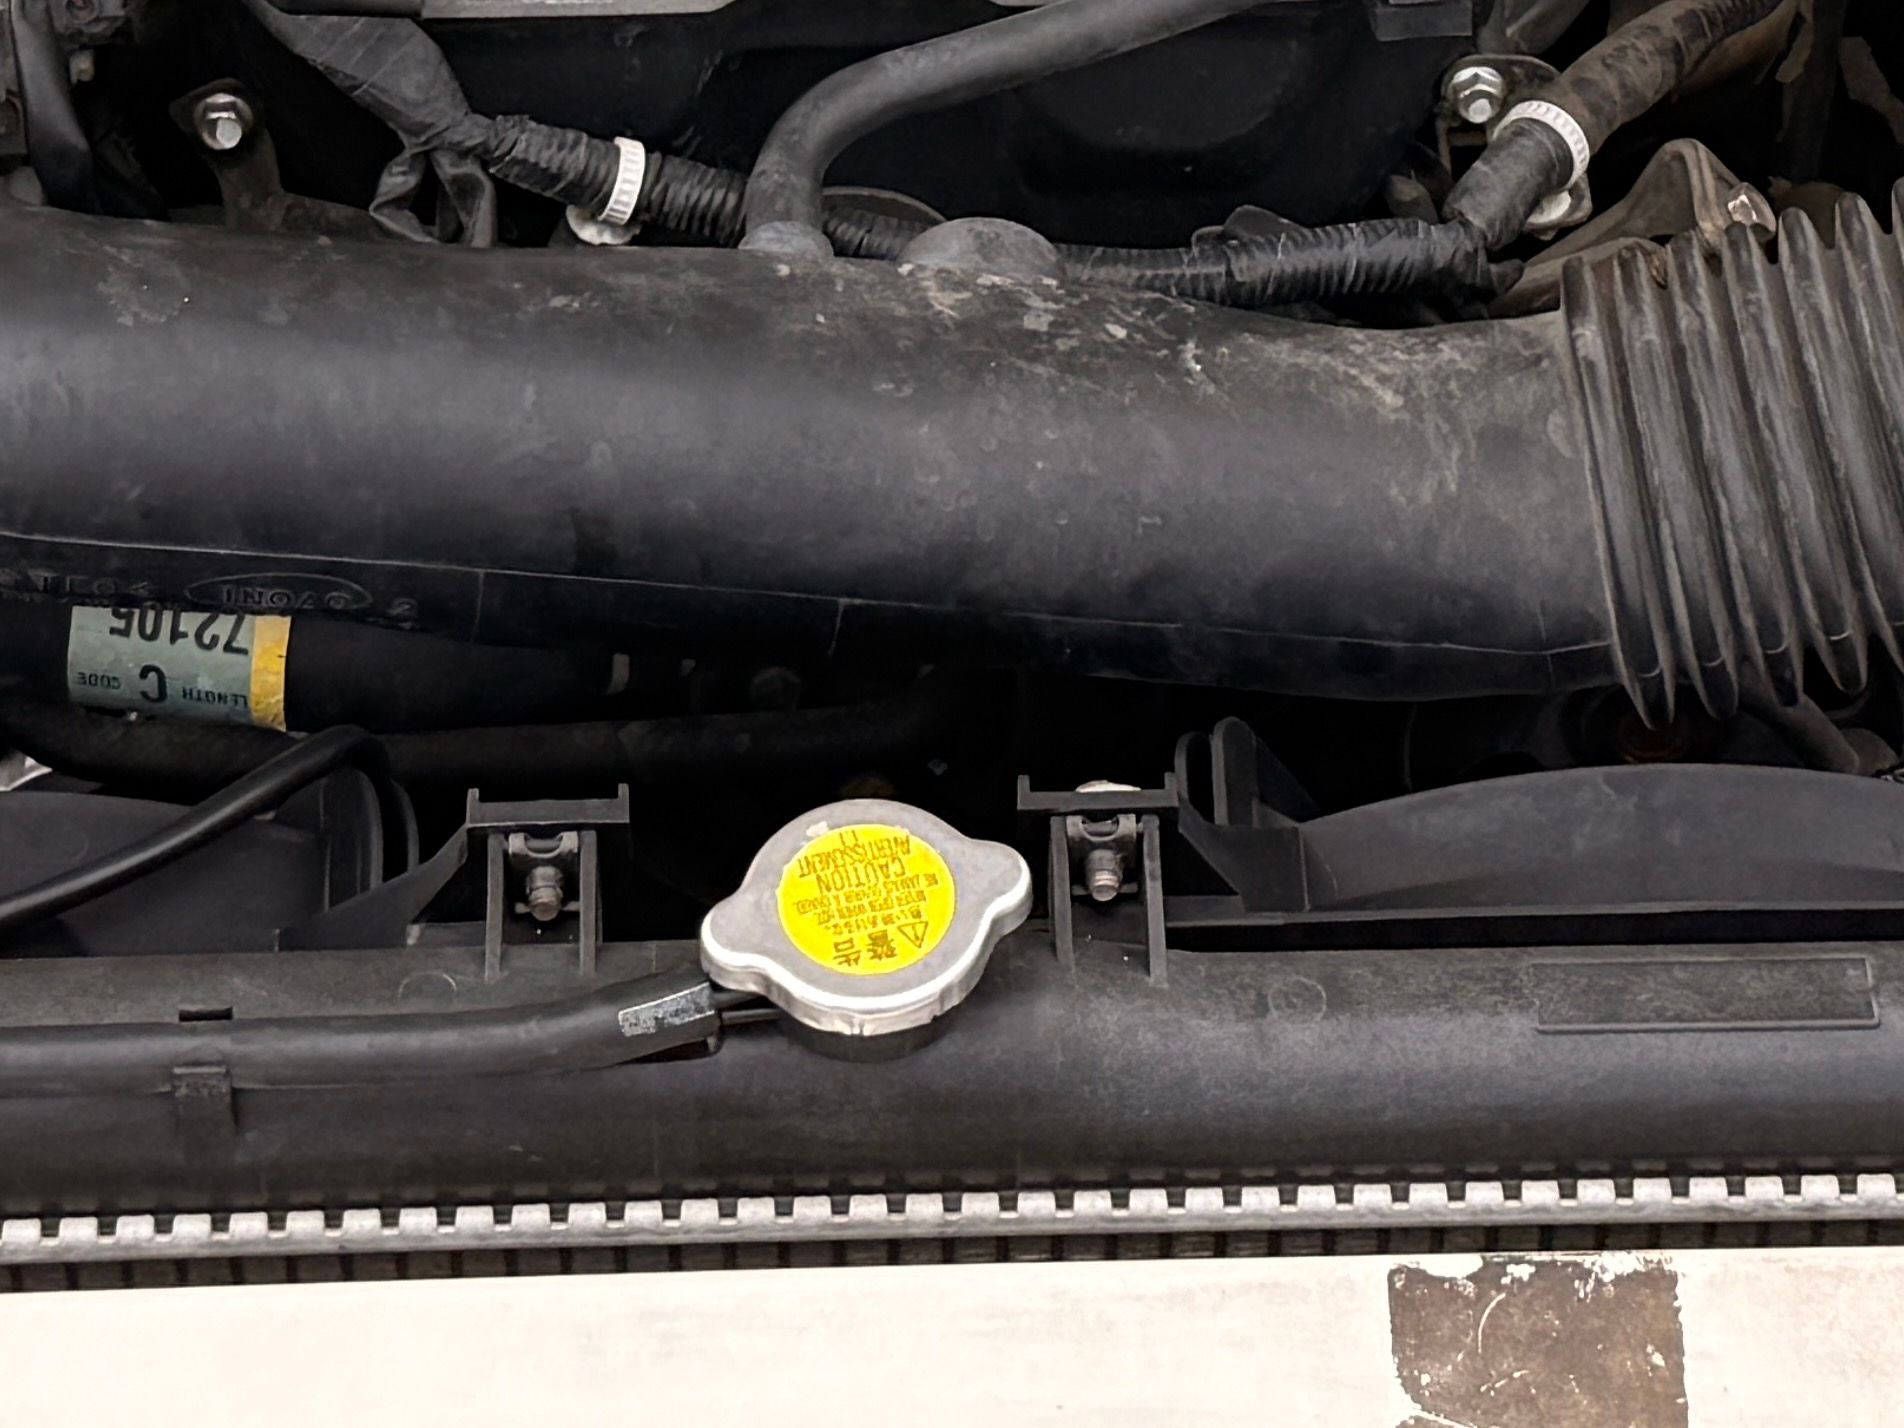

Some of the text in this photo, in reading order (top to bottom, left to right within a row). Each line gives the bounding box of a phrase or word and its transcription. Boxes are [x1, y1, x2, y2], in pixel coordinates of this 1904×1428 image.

[108, 604, 251, 656] 72105
[75, 663, 249, 710] LENGTH C CODE
[796, 835, 912, 878] AVERTISSEMENT
[814, 856, 907, 895] CAUTION
